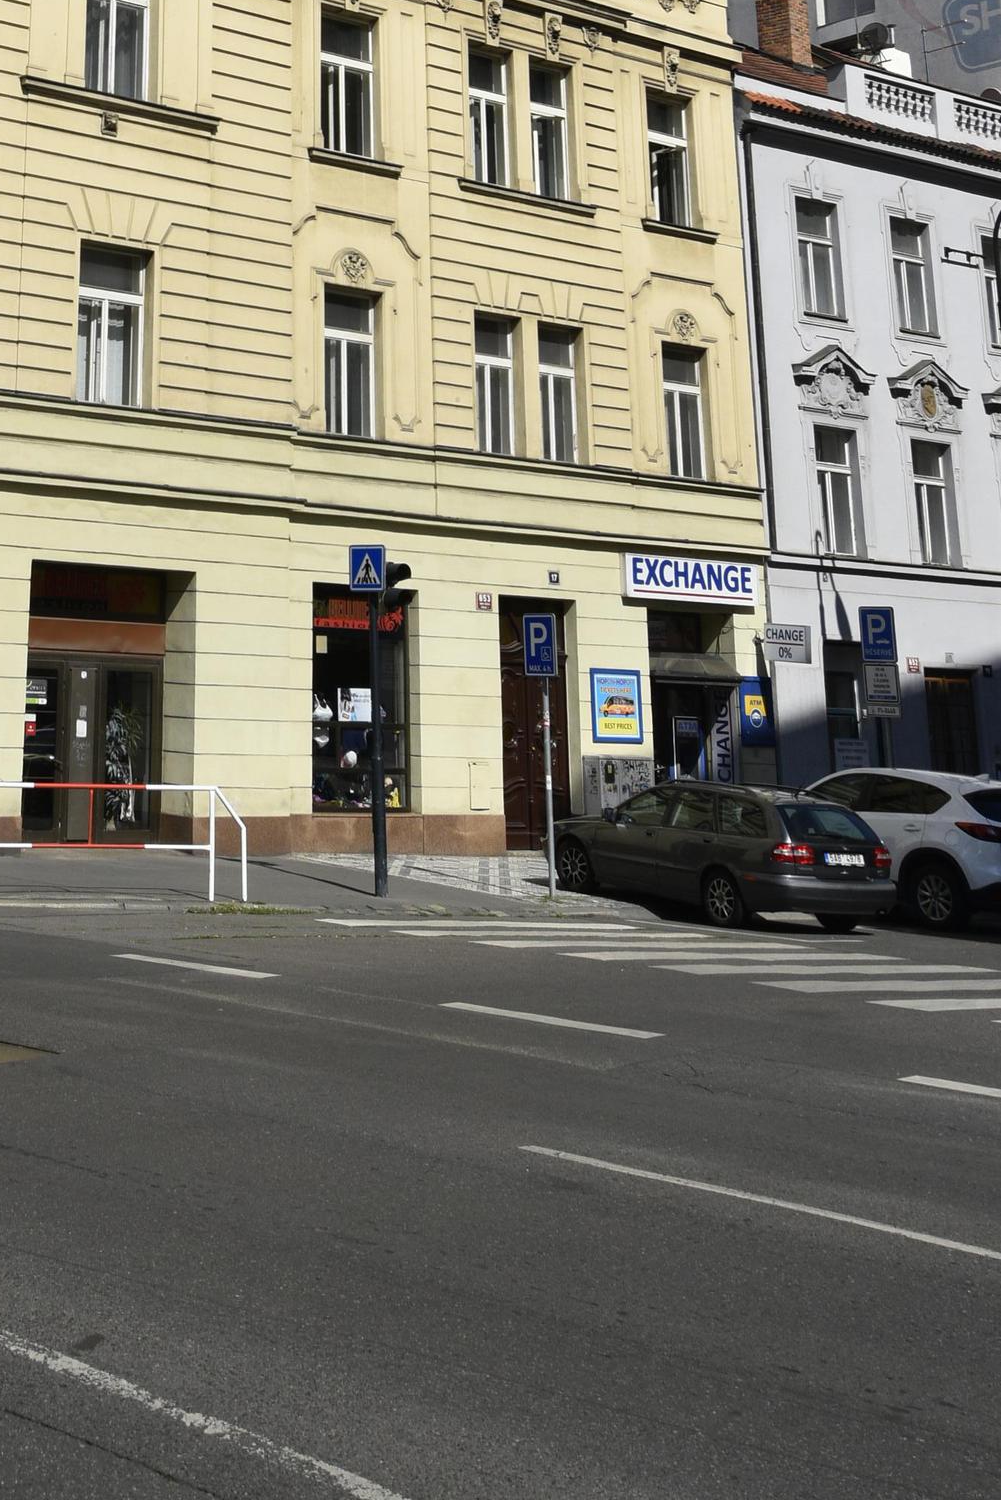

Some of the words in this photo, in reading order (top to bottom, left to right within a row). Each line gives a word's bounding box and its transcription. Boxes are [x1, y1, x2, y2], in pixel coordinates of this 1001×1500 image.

[632, 557, 753, 594] EXCHANGE
[529, 622, 548, 657] P
[765, 627, 804, 642] CHANGE
[866, 614, 886, 644] P
[778, 646, 793, 659] 0%
[604, 722, 616, 730] BEST
[616, 723, 633, 731] PRICES
